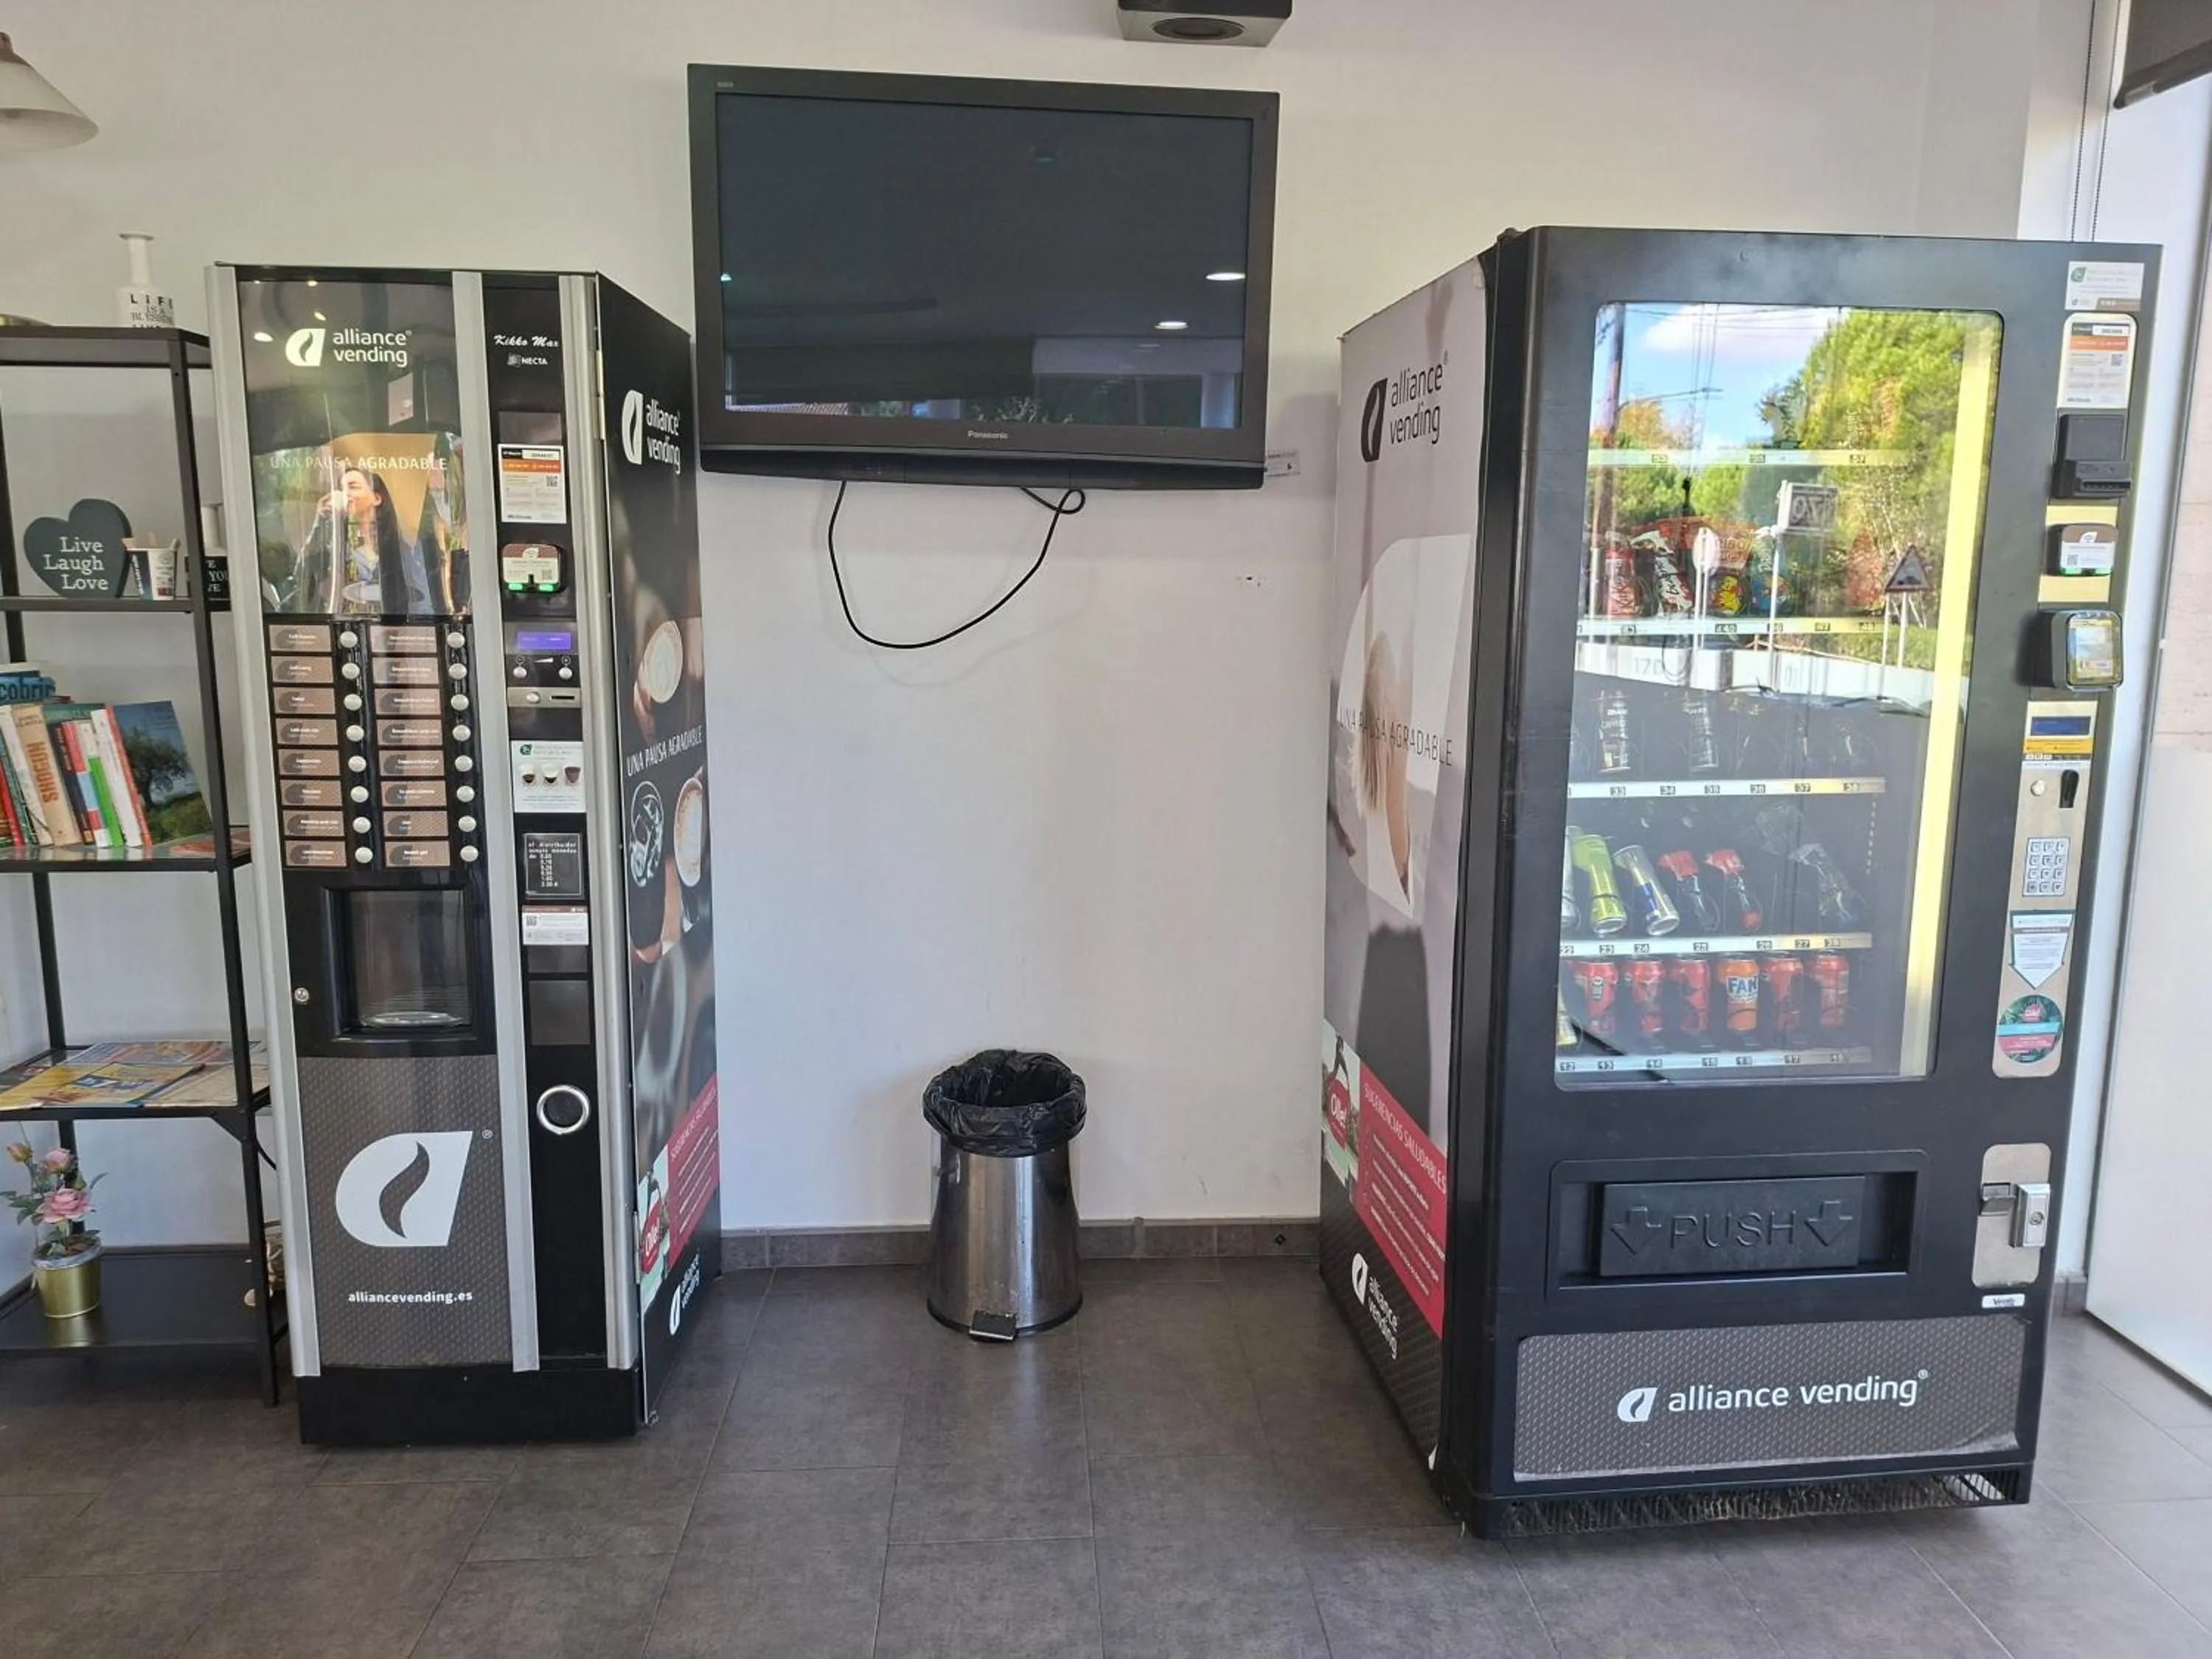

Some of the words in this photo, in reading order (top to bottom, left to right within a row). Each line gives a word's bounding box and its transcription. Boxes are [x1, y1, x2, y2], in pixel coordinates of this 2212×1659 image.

[333, 328, 406, 346] alliance
[493, 335, 528, 346] Kikko
[333, 347, 408, 368] vending
[521, 357, 548, 365] NECTA
[1391, 363, 1443, 407] alliance
[1391, 401, 1440, 445] vending
[967, 430, 1009, 439] Panasonic
[306, 456, 352, 470] PAUSA
[358, 456, 448, 470] AGRADABLE
[647, 435, 681, 475] vending
[59, 536, 104, 553] Live
[44, 554, 105, 575] Laugh
[61, 574, 109, 591] Love
[1390, 720, 1452, 766] AGRADABLE
[1671, 1209, 1796, 1249] PUSH
[348, 1291, 473, 1304] alliancevending.es
[1668, 1384, 1790, 1412] alliance
[1799, 1375, 1917, 1408] vending
